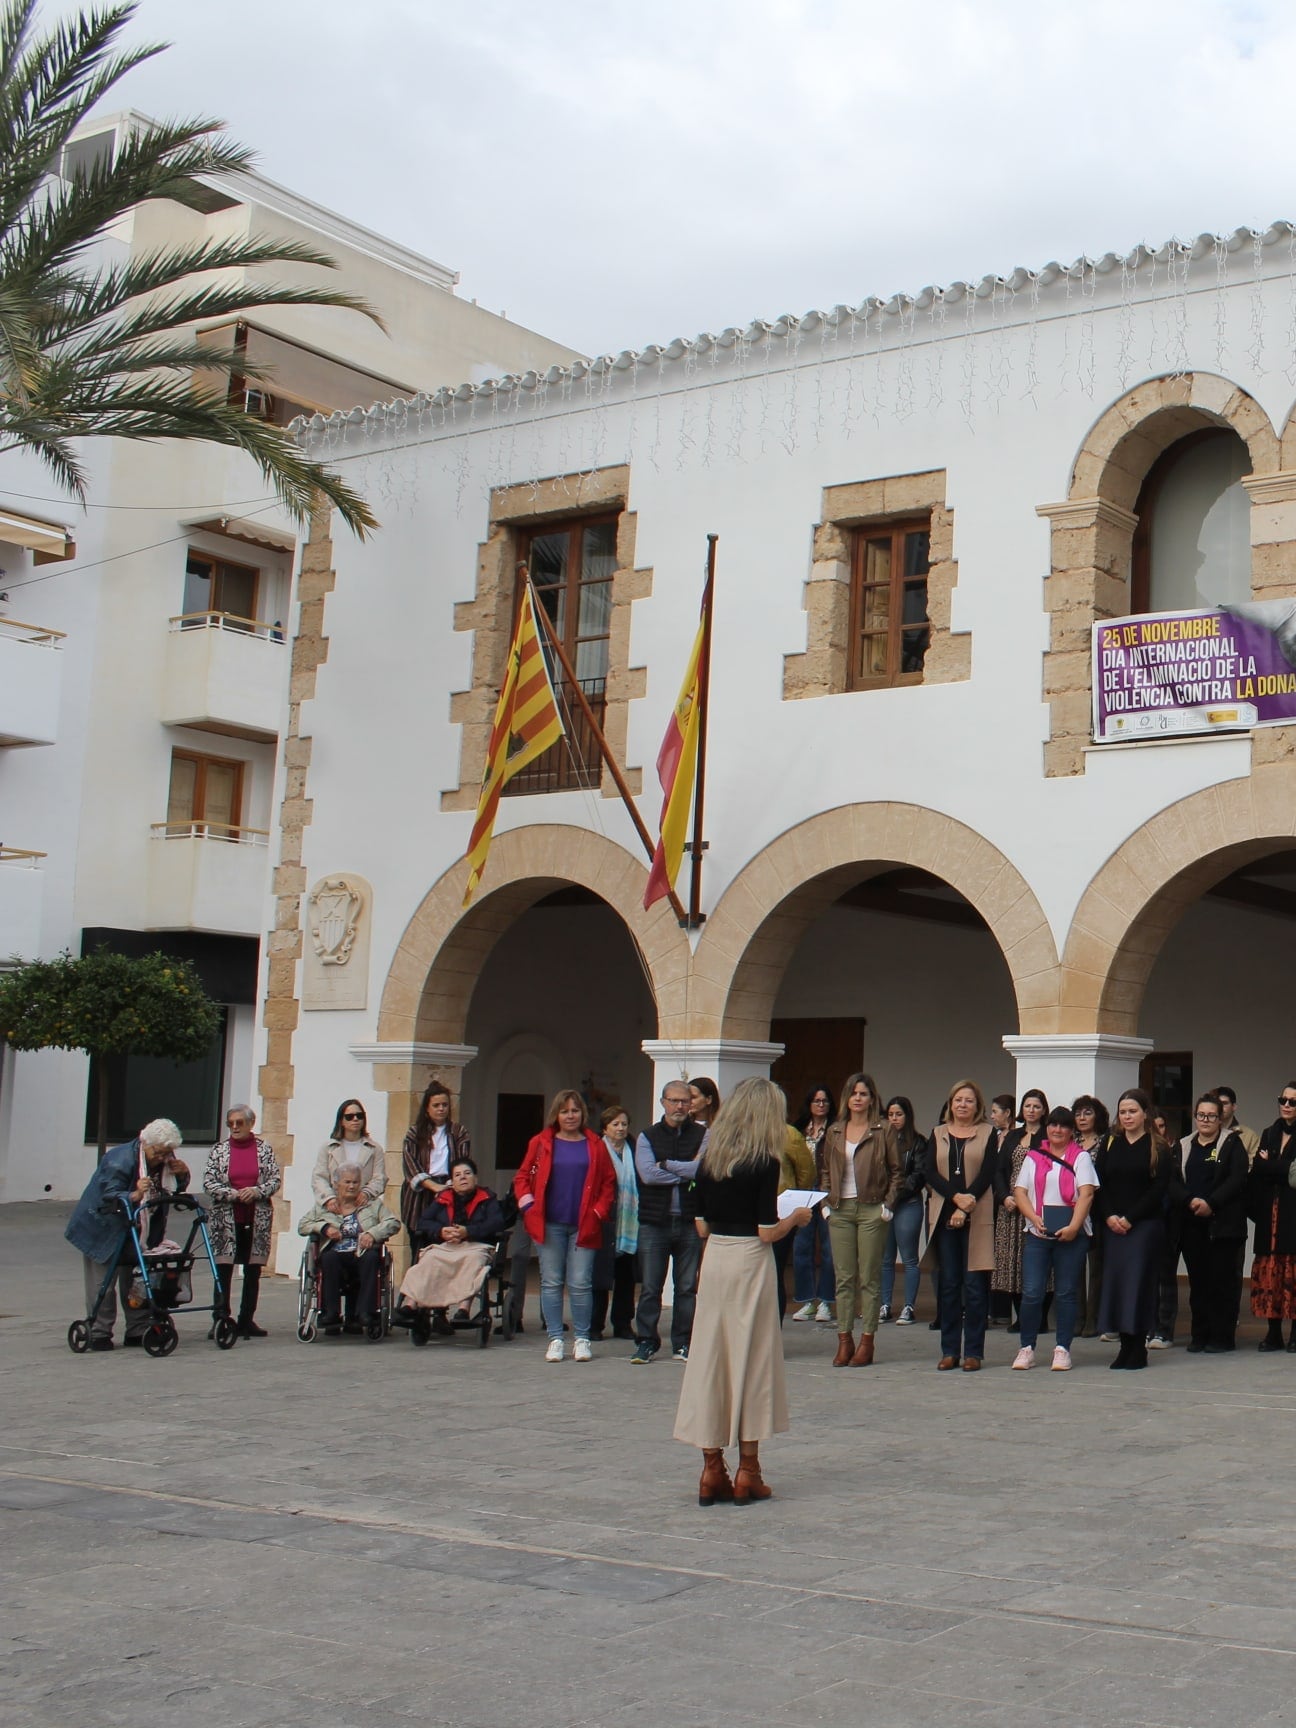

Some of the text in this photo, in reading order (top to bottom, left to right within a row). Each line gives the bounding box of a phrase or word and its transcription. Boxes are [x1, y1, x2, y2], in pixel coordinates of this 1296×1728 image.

[1102, 616, 1221, 649] 25 DE NOVEMBRE
[1102, 636, 1239, 670] DIA INTERNACIONAL
[1103, 655, 1257, 691] DE L'ELIMINACIÓ DE LA
[1175, 679, 1232, 705] CONTRA
[1236, 677, 1255, 699] LA
